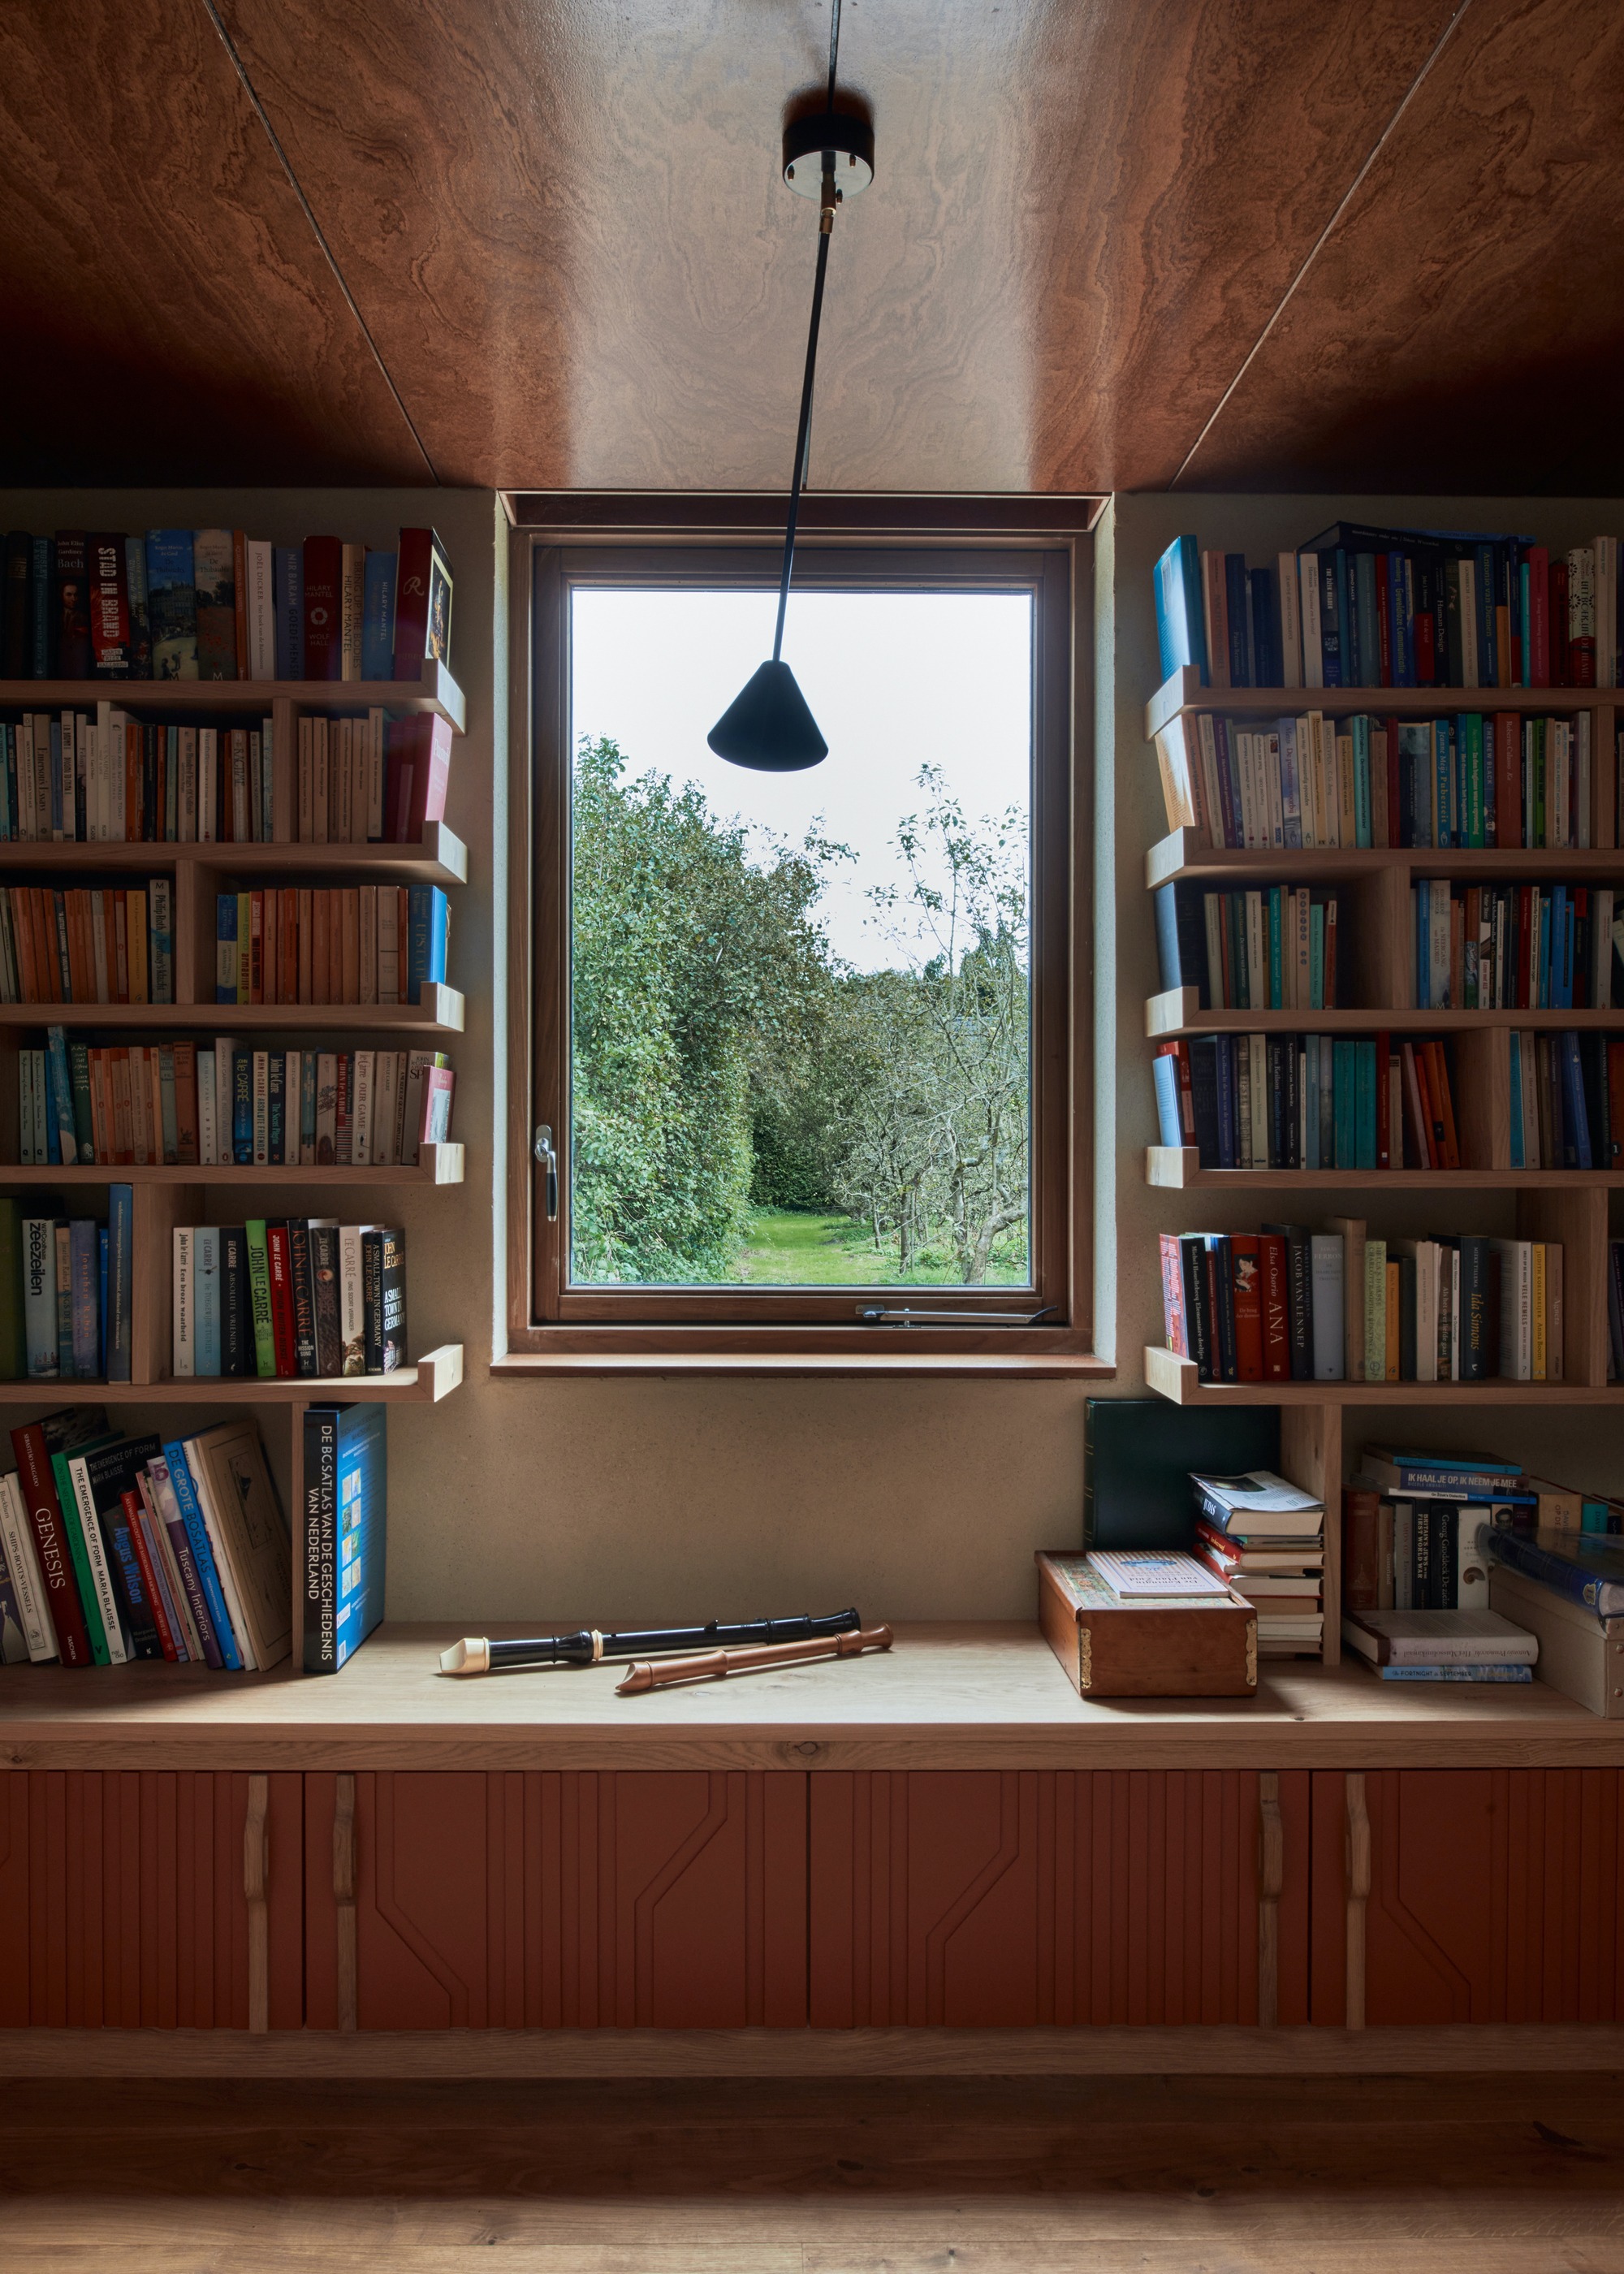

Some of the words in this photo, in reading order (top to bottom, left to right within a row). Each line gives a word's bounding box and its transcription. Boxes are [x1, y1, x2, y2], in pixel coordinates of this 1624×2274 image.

[58, 559, 84, 568] Bach
[97, 547, 117, 577] STAD
[287, 554, 296, 571] NIR
[100, 582, 118, 594] IN
[288, 573, 297, 605] BARAM
[353, 561, 362, 592] BRING
[354, 595, 361, 607] UP
[1395, 588, 1405, 625] Geweldloze
[102, 599, 119, 638] BRAND
[289, 609, 298, 641] GOEDE
[353, 612, 361, 630] THE
[343, 614, 352, 654] MANTEL
[353, 633, 361, 668] BODIES
[1397, 627, 1406, 674] Communicatie
[37, 747, 48, 785] Emerson's
[234, 748, 244, 786] RAGTIME
[1507, 772, 1513, 780] Ka
[38, 787, 49, 811] Essays
[153, 894, 166, 914] Philip
[155, 915, 166, 931] Roth
[155, 939, 166, 970] Portnoy's
[156, 970, 167, 991] klacht
[270, 1058, 283, 1072] John
[257, 1078, 266, 1096] CARRÉ
[270, 1079, 283, 1094] Carré
[272, 1103, 281, 1113] The
[272, 1113, 280, 1126] Secret
[257, 1126, 266, 1151] FRIENDS
[270, 1128, 281, 1144] Pilgrim
[179, 1234, 188, 1245] John
[292, 1230, 307, 1268] JOHN
[30, 1222, 45, 1295] zeezeilen
[180, 1252, 188, 1265] Carré
[250, 1246, 265, 1274] JOHN
[1269, 1246, 1277, 1265] Elsa
[1293, 1245, 1302, 1278] JACOB
[80, 1252, 90, 1299] Jonathan
[255, 1276, 266, 1286] LE
[295, 1272, 304, 1285] LE
[1269, 1267, 1278, 1297] Osorio
[253, 1288, 271, 1324] CARRÉ
[296, 1286, 313, 1337] CARRÉ
[374, 1299, 380, 1307] IN
[1471, 1293, 1484, 1310] Ida
[1268, 1301, 1284, 1344] ANA
[1296, 1306, 1304, 1347] LENNEP
[1471, 1312, 1482, 1350] Simons
[322, 1425, 332, 1443] DE
[168, 1450, 182, 1467] DE
[173, 1468, 194, 1510] GROTE
[322, 1447, 332, 1511] BOSATLAS
[1408, 1473, 1415, 1482] IK
[1416, 1474, 1436, 1483] HAAL
[1437, 1475, 1446, 1483] JE
[1447, 1476, 1459, 1485] OP,
[1469, 1477, 1490, 1486] NEEM
[1491, 1478, 1500, 1486] JE
[1501, 1479, 1517, 1487] MEE
[80, 1486, 94, 1533] EMERGENCE
[309, 1488, 319, 1514] VAN
[1203, 1498, 1217, 1516] JUDAS
[89, 1533, 97, 1544] OF
[322, 1512, 332, 1539] VAN
[35, 1507, 66, 1589] GENESIS
[92, 1545, 102, 1567] FORM
[186, 1512, 211, 1574] BOSATLAS
[322, 1542, 332, 1560] DE
[114, 1527, 132, 1562] Angus
[123, 1562, 143, 1604] Wilson
[309, 1517, 319, 1599] NEDERLAND
[97, 1571, 107, 1594] MARIA
[178, 1547, 197, 1592] Tuscany
[192, 1593, 210, 1641] Interiors
[102, 1595, 115, 1631] BLAISSE
[322, 1563, 332, 1660] GESCHIEDENIS
[67, 1636, 77, 1660] TASCHEN
